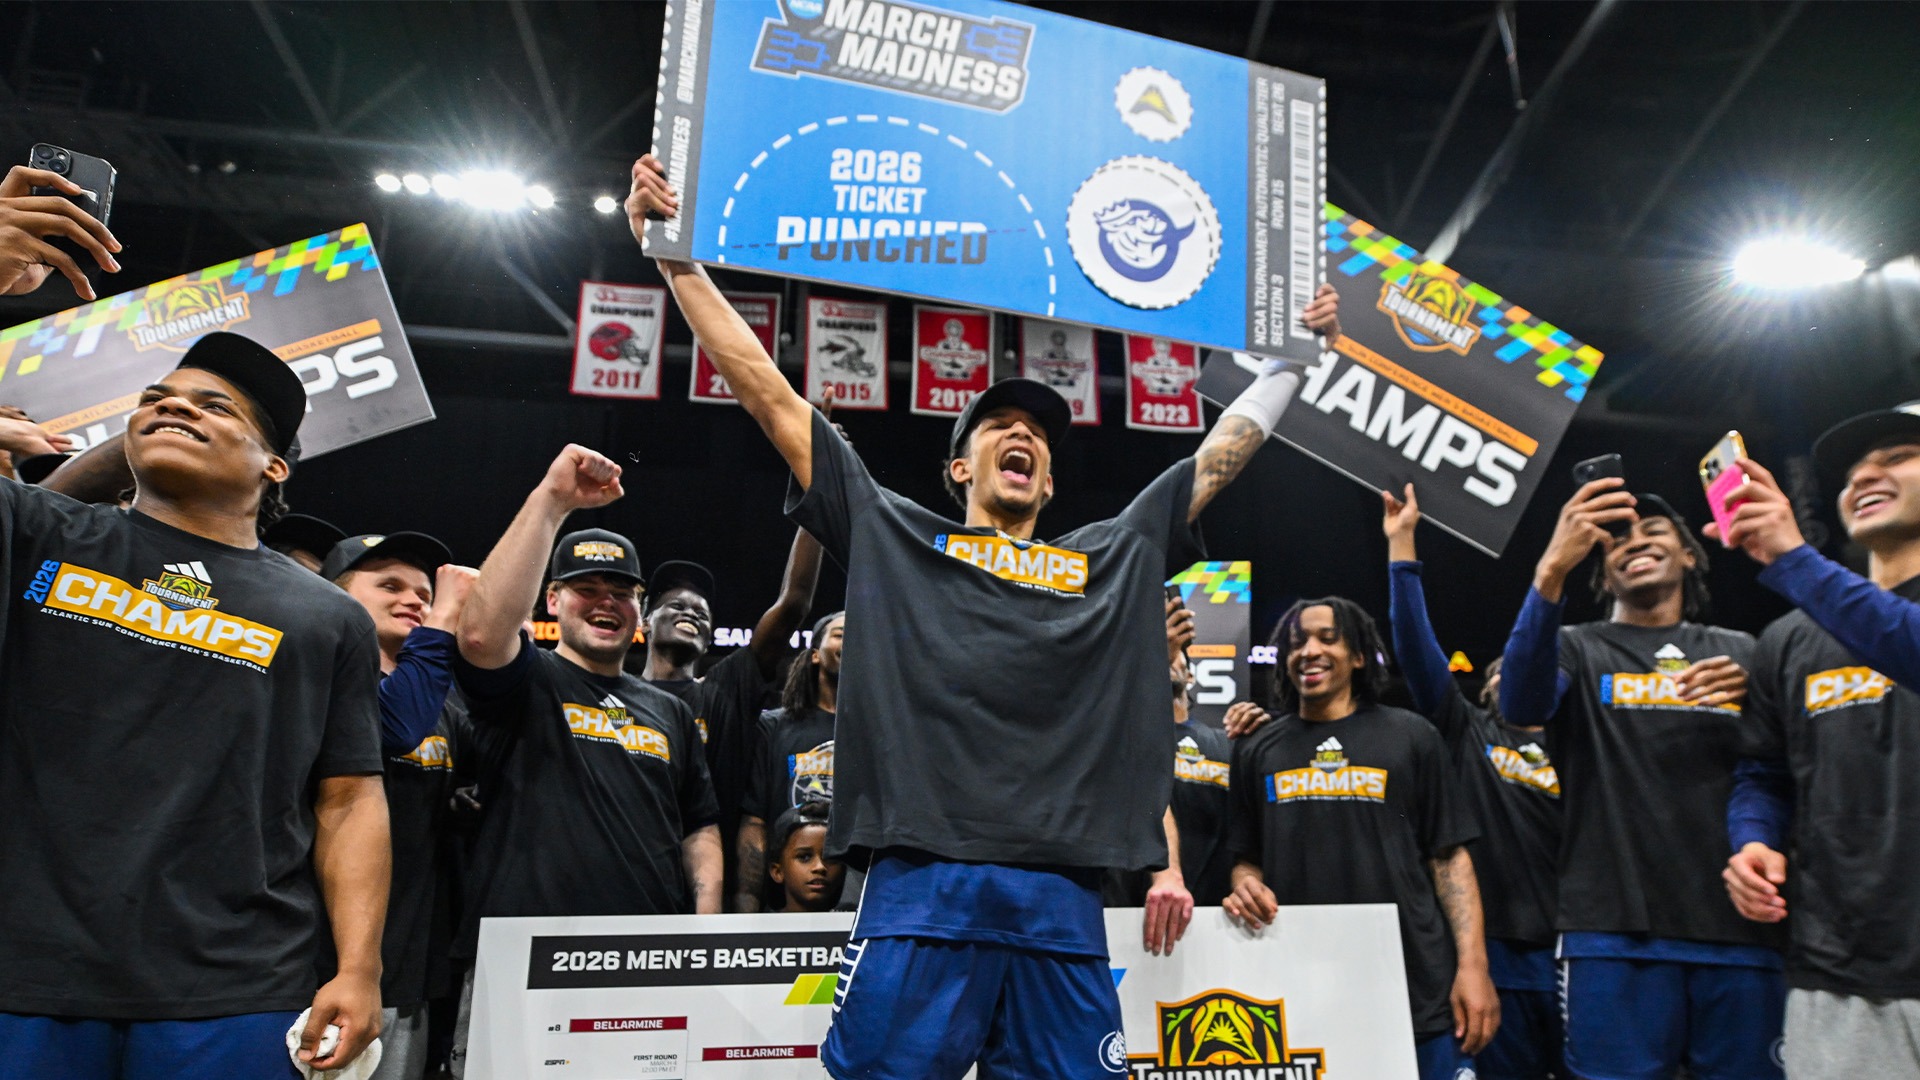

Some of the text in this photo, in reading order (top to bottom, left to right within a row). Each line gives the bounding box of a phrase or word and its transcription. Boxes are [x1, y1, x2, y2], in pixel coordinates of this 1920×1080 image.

[823, 0, 962, 52] MARCH
[837, 32, 1022, 100] MADNESS
[830, 148, 922, 183] 2026
[833, 184, 927, 214] TICKET
[1255, 77, 1269, 346] NCAA TOURNAMENT AUTOMATIC QUALIFIER
[1271, 198, 1284, 230] ROW
[776, 216, 988, 265] PUNCHED
[134, 297, 245, 346] TOURNAMENT
[1270, 274, 1284, 347] SECTION 3
[1382, 286, 1477, 348] TOURNAMENT
[592, 368, 640, 389] 2011
[1140, 402, 1190, 425] 2023
[1233, 349, 1528, 507] HAMPS
[933, 534, 947, 553] 26
[23, 559, 60, 604] 2026
[949, 541, 1086, 587] CHAMPS
[55, 572, 275, 658] CHAMPS
[145, 581, 216, 609] TOURNAMENT
[40, 607, 268, 674] ATLANTIC SUN CONFERENCE MEN'S BASKETBALL
[1615, 677, 1680, 700] CHA
[1810, 670, 1888, 704] CHA
[563, 707, 668, 754] CHAMPS
[1277, 770, 1384, 795] CHAMPS
[552, 946, 846, 972] 2026 MEN'S BASKETBA
[593, 1019, 664, 1030] BELLARMINE
[725, 1047, 795, 1058] BELLARMINE
